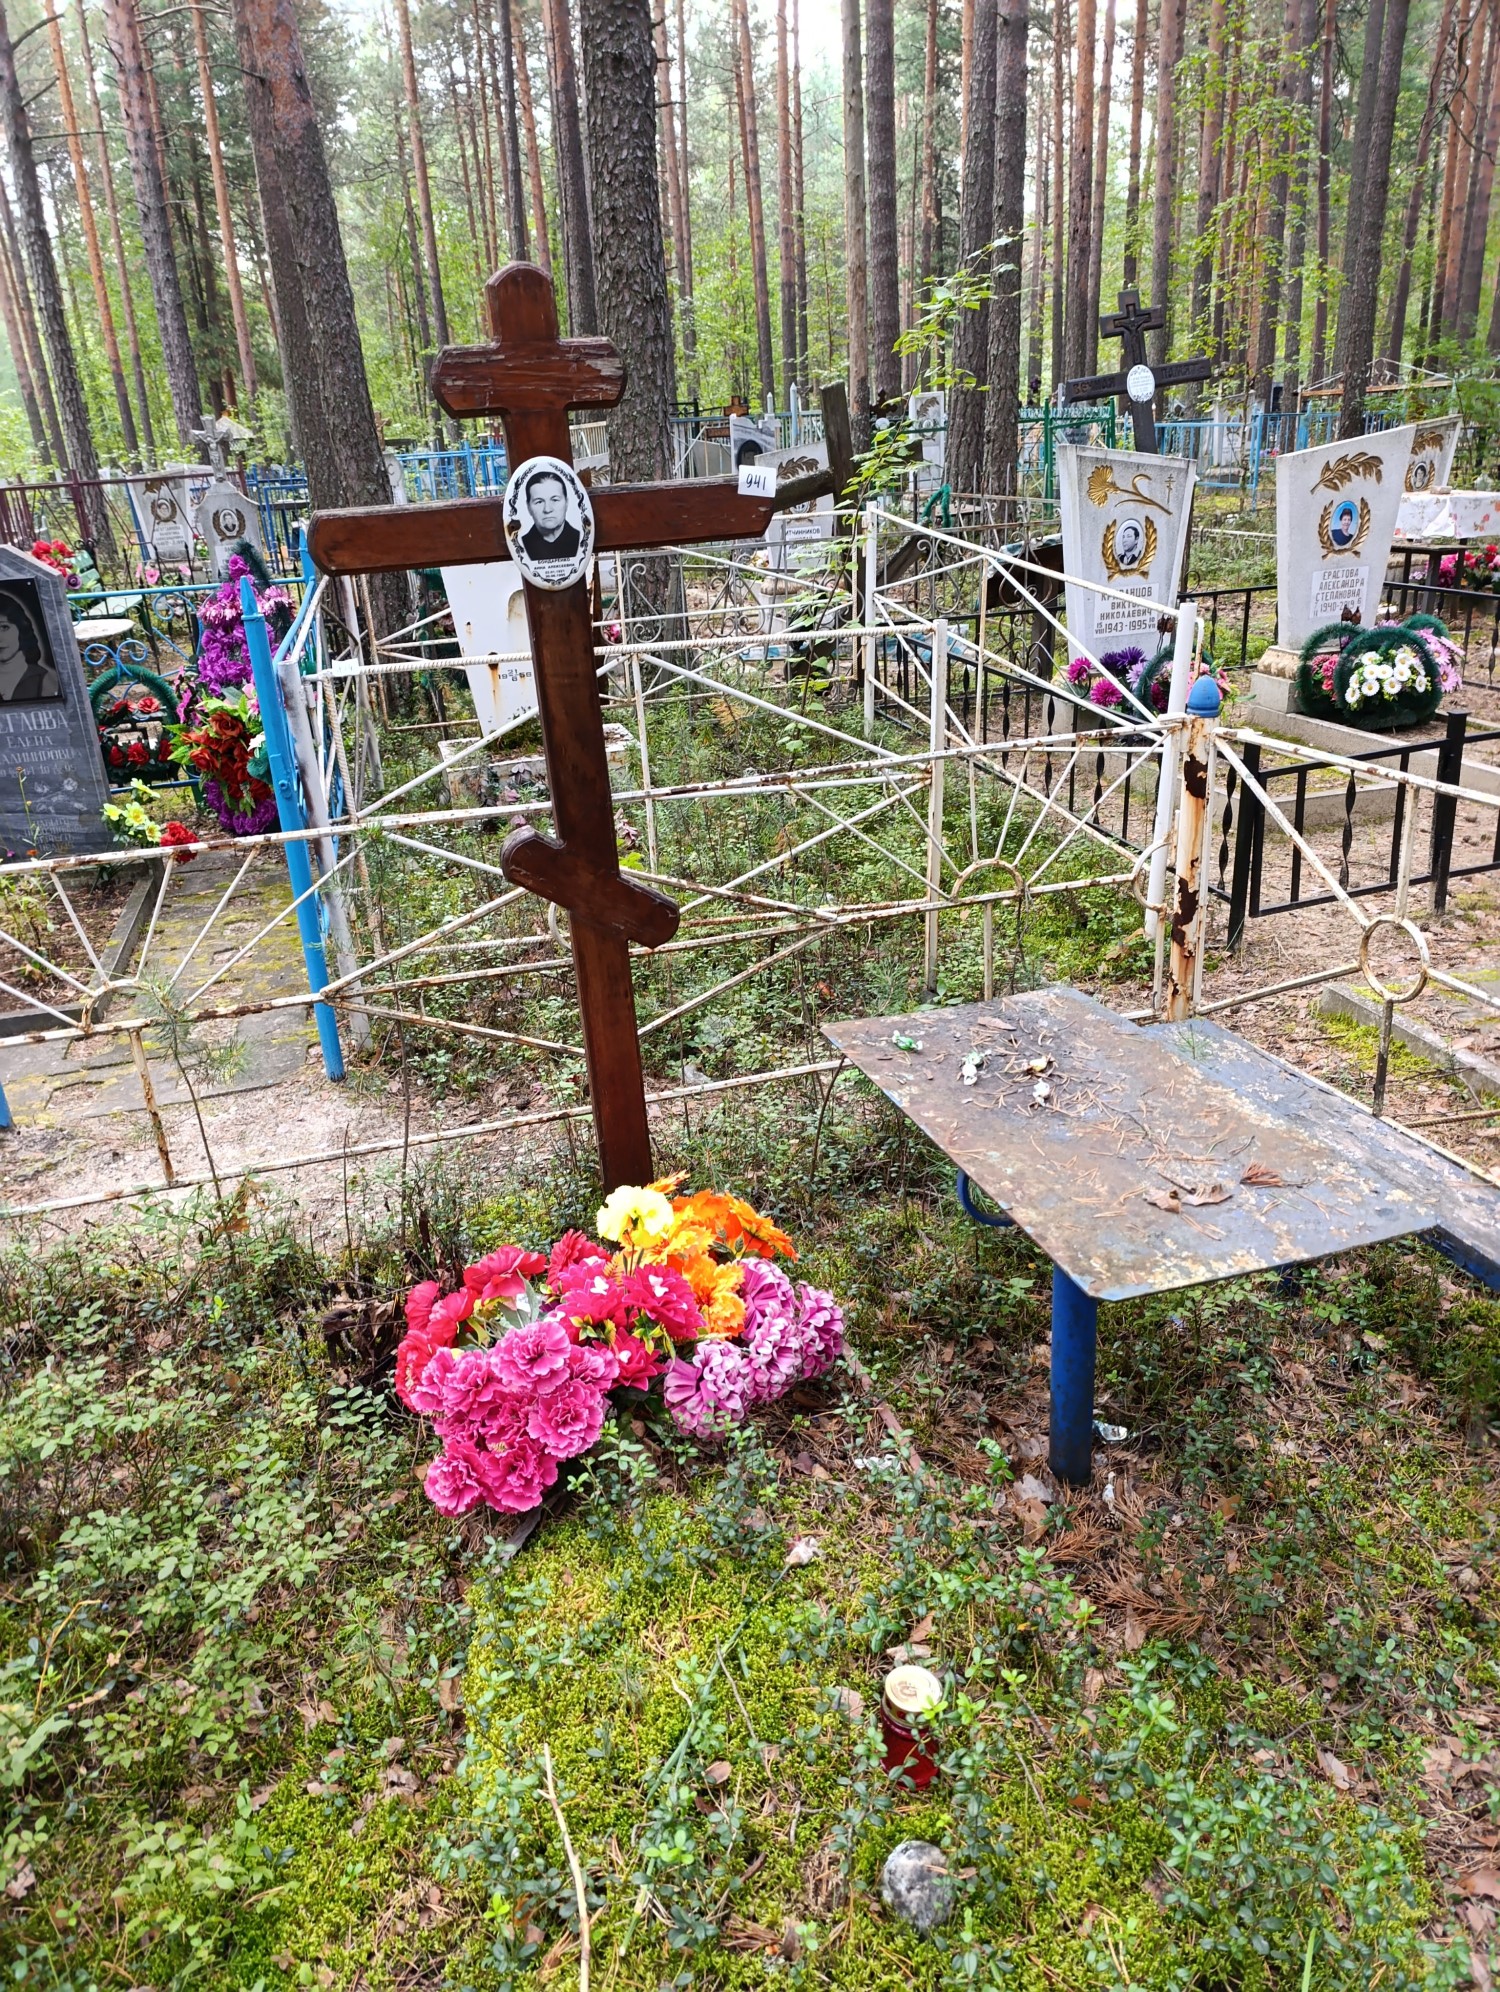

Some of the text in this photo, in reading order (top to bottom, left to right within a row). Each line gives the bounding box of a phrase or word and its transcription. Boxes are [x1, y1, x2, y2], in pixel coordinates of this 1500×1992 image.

[746, 473, 767, 491] 941
[1322, 568, 1359, 580] ЕРАСТОВА
[1319, 578, 1364, 591] АЛЕКСАНДРА
[1101, 586, 1152, 601] КРАНЦОВ
[1315, 589, 1361, 602] СТЕПАНОВНА
[1111, 600, 1141, 610] ВИКТО
[1100, 608, 1152, 620] НИКОЛАЕВИЧ
[6, 735, 53, 749] ЕЛЕНА
